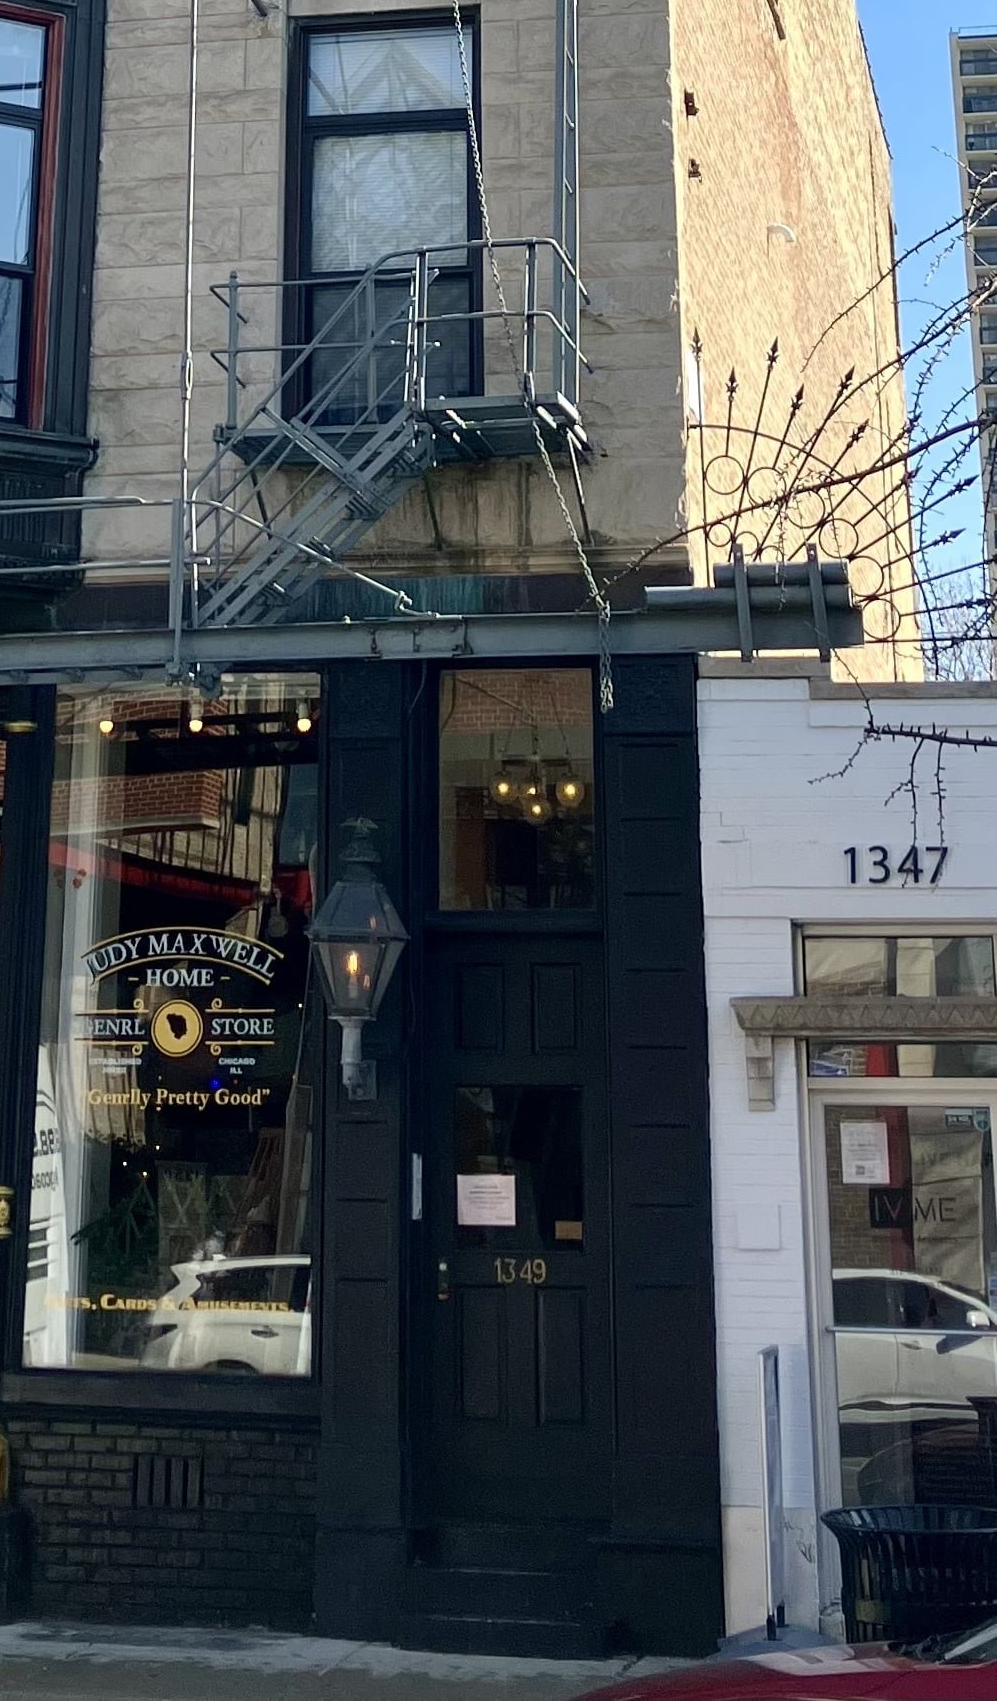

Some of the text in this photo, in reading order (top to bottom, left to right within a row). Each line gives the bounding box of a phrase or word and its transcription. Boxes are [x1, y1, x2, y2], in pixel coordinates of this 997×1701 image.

[843, 845, 949, 886] 1347
[84, 933, 276, 986] JUDY MAXWELL
[145, 968, 215, 988] HOME
[210, 1018, 275, 1036] STORE
[218, 1058, 256, 1066] CHICAGO
[154, 1088, 210, 1111] Pretty
[213, 1088, 271, 1106] Good"
[493, 1257, 547, 1285] 1349
